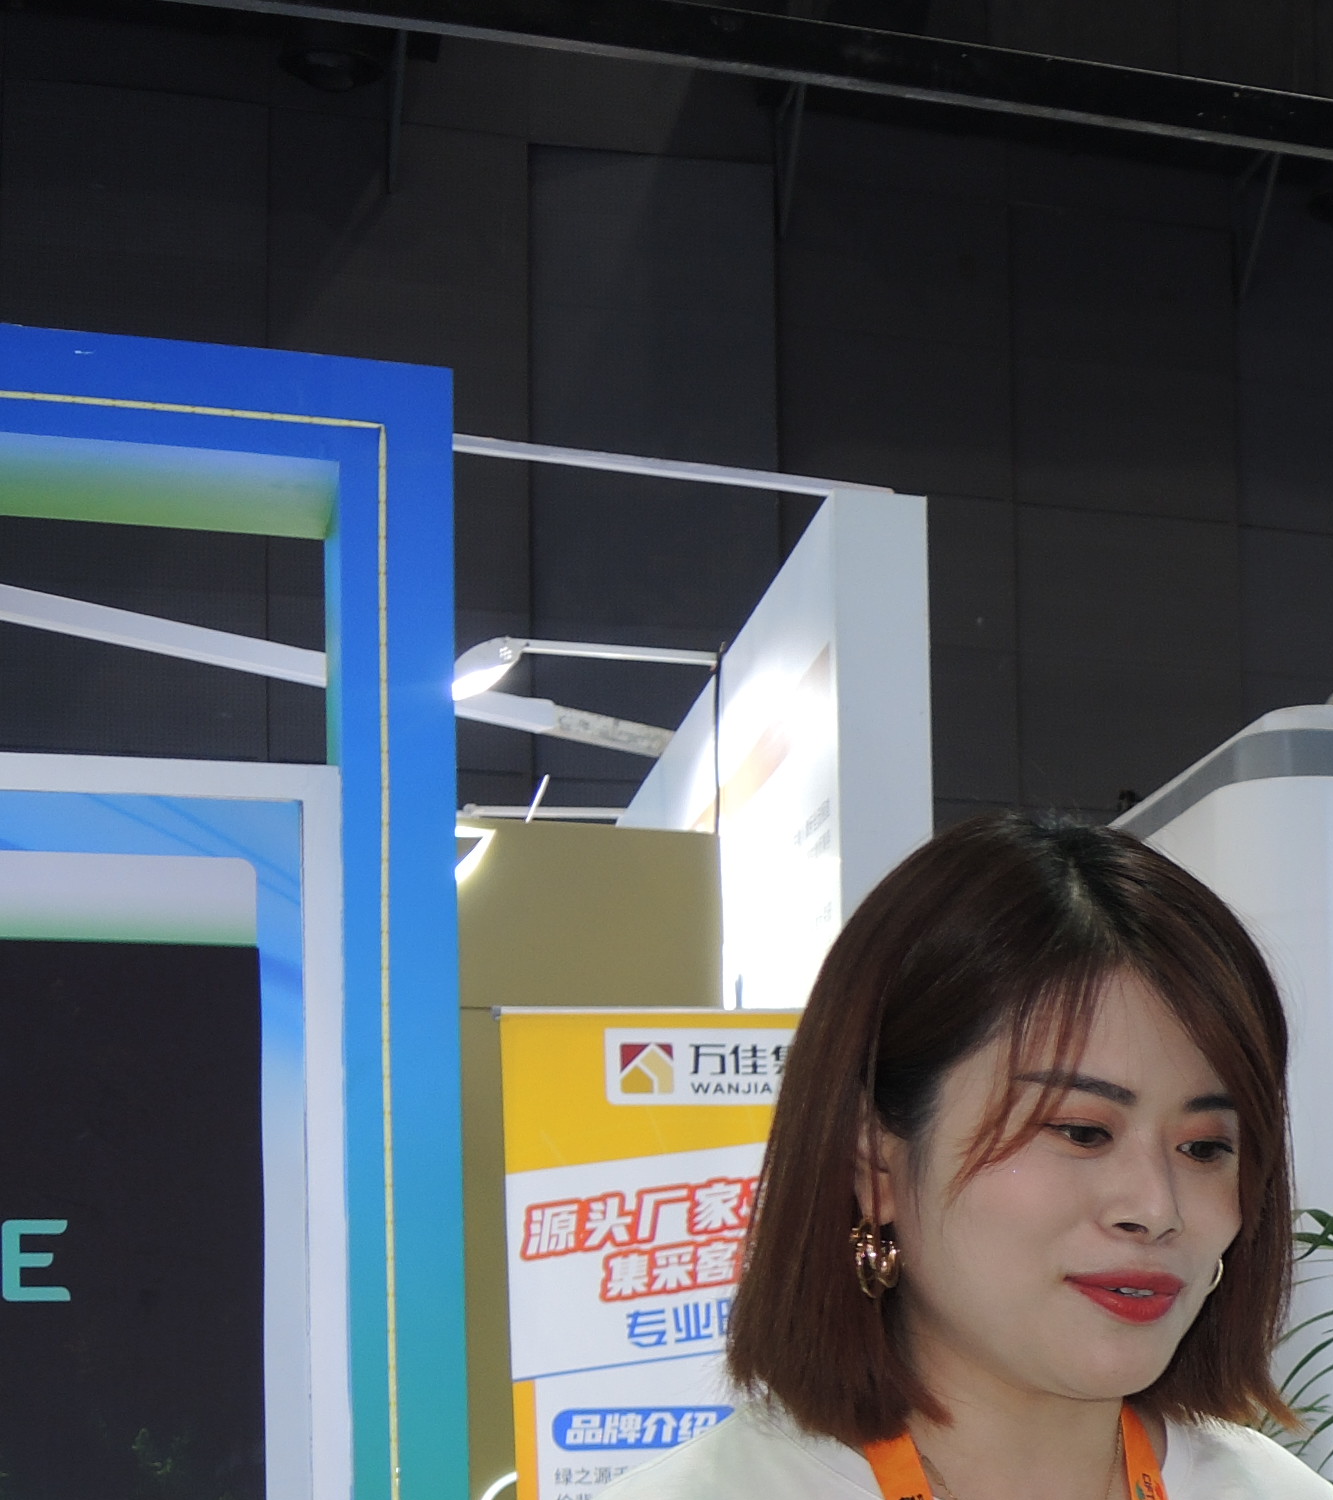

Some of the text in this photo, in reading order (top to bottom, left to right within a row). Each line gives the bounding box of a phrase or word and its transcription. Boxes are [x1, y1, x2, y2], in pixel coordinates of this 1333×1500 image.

[691, 1082, 773, 1095] WANJIA
[1, 1218, 72, 1302] E
[565, 1410, 717, 1445] 品牌介绍
